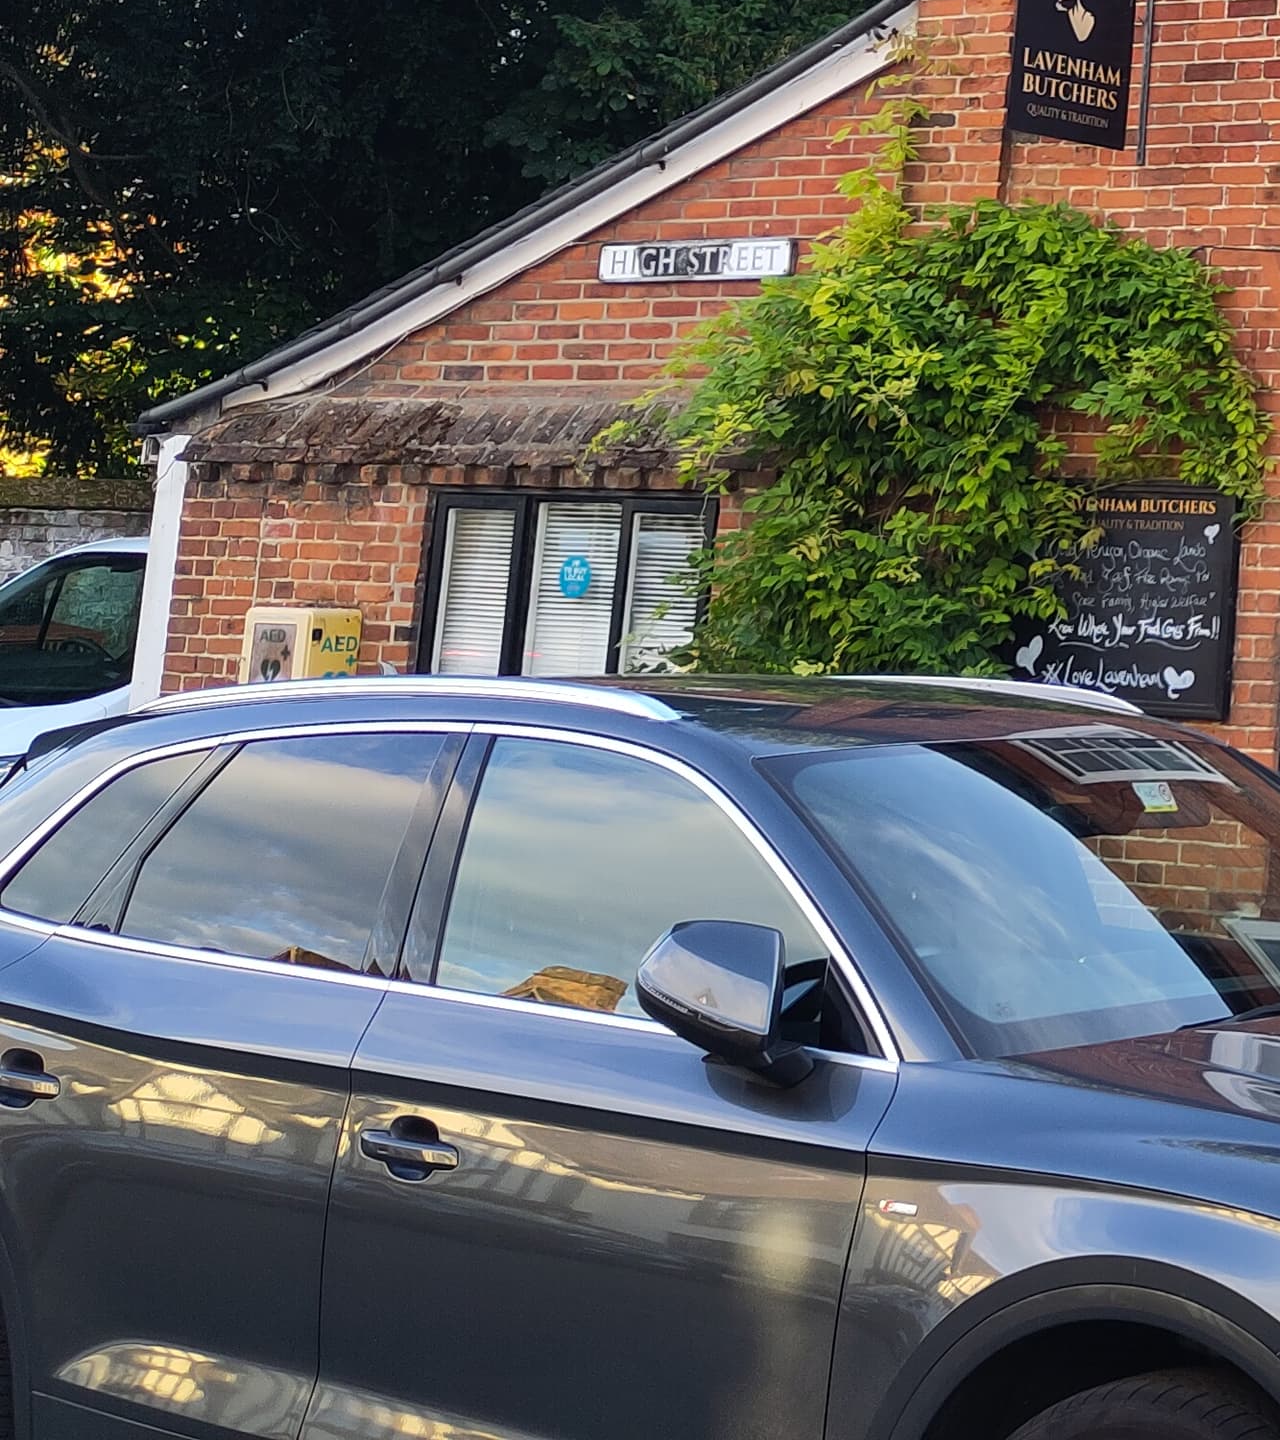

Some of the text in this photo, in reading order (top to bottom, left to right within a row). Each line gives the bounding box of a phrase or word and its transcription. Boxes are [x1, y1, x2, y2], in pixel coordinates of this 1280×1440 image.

[1023, 47, 1121, 87] LAVENHAM
[1022, 72, 1118, 111] BUTCHERS
[1026, 103, 1110, 129] QUALITY & TRADITION
[611, 245, 780, 276] HIGH STREET
[1140, 498, 1217, 515] BUTCHERS
[1134, 519, 1184, 531] TRADITION
[260, 628, 287, 643] AED
[320, 636, 358, 653] AED
[1063, 655, 1096, 688] Love
